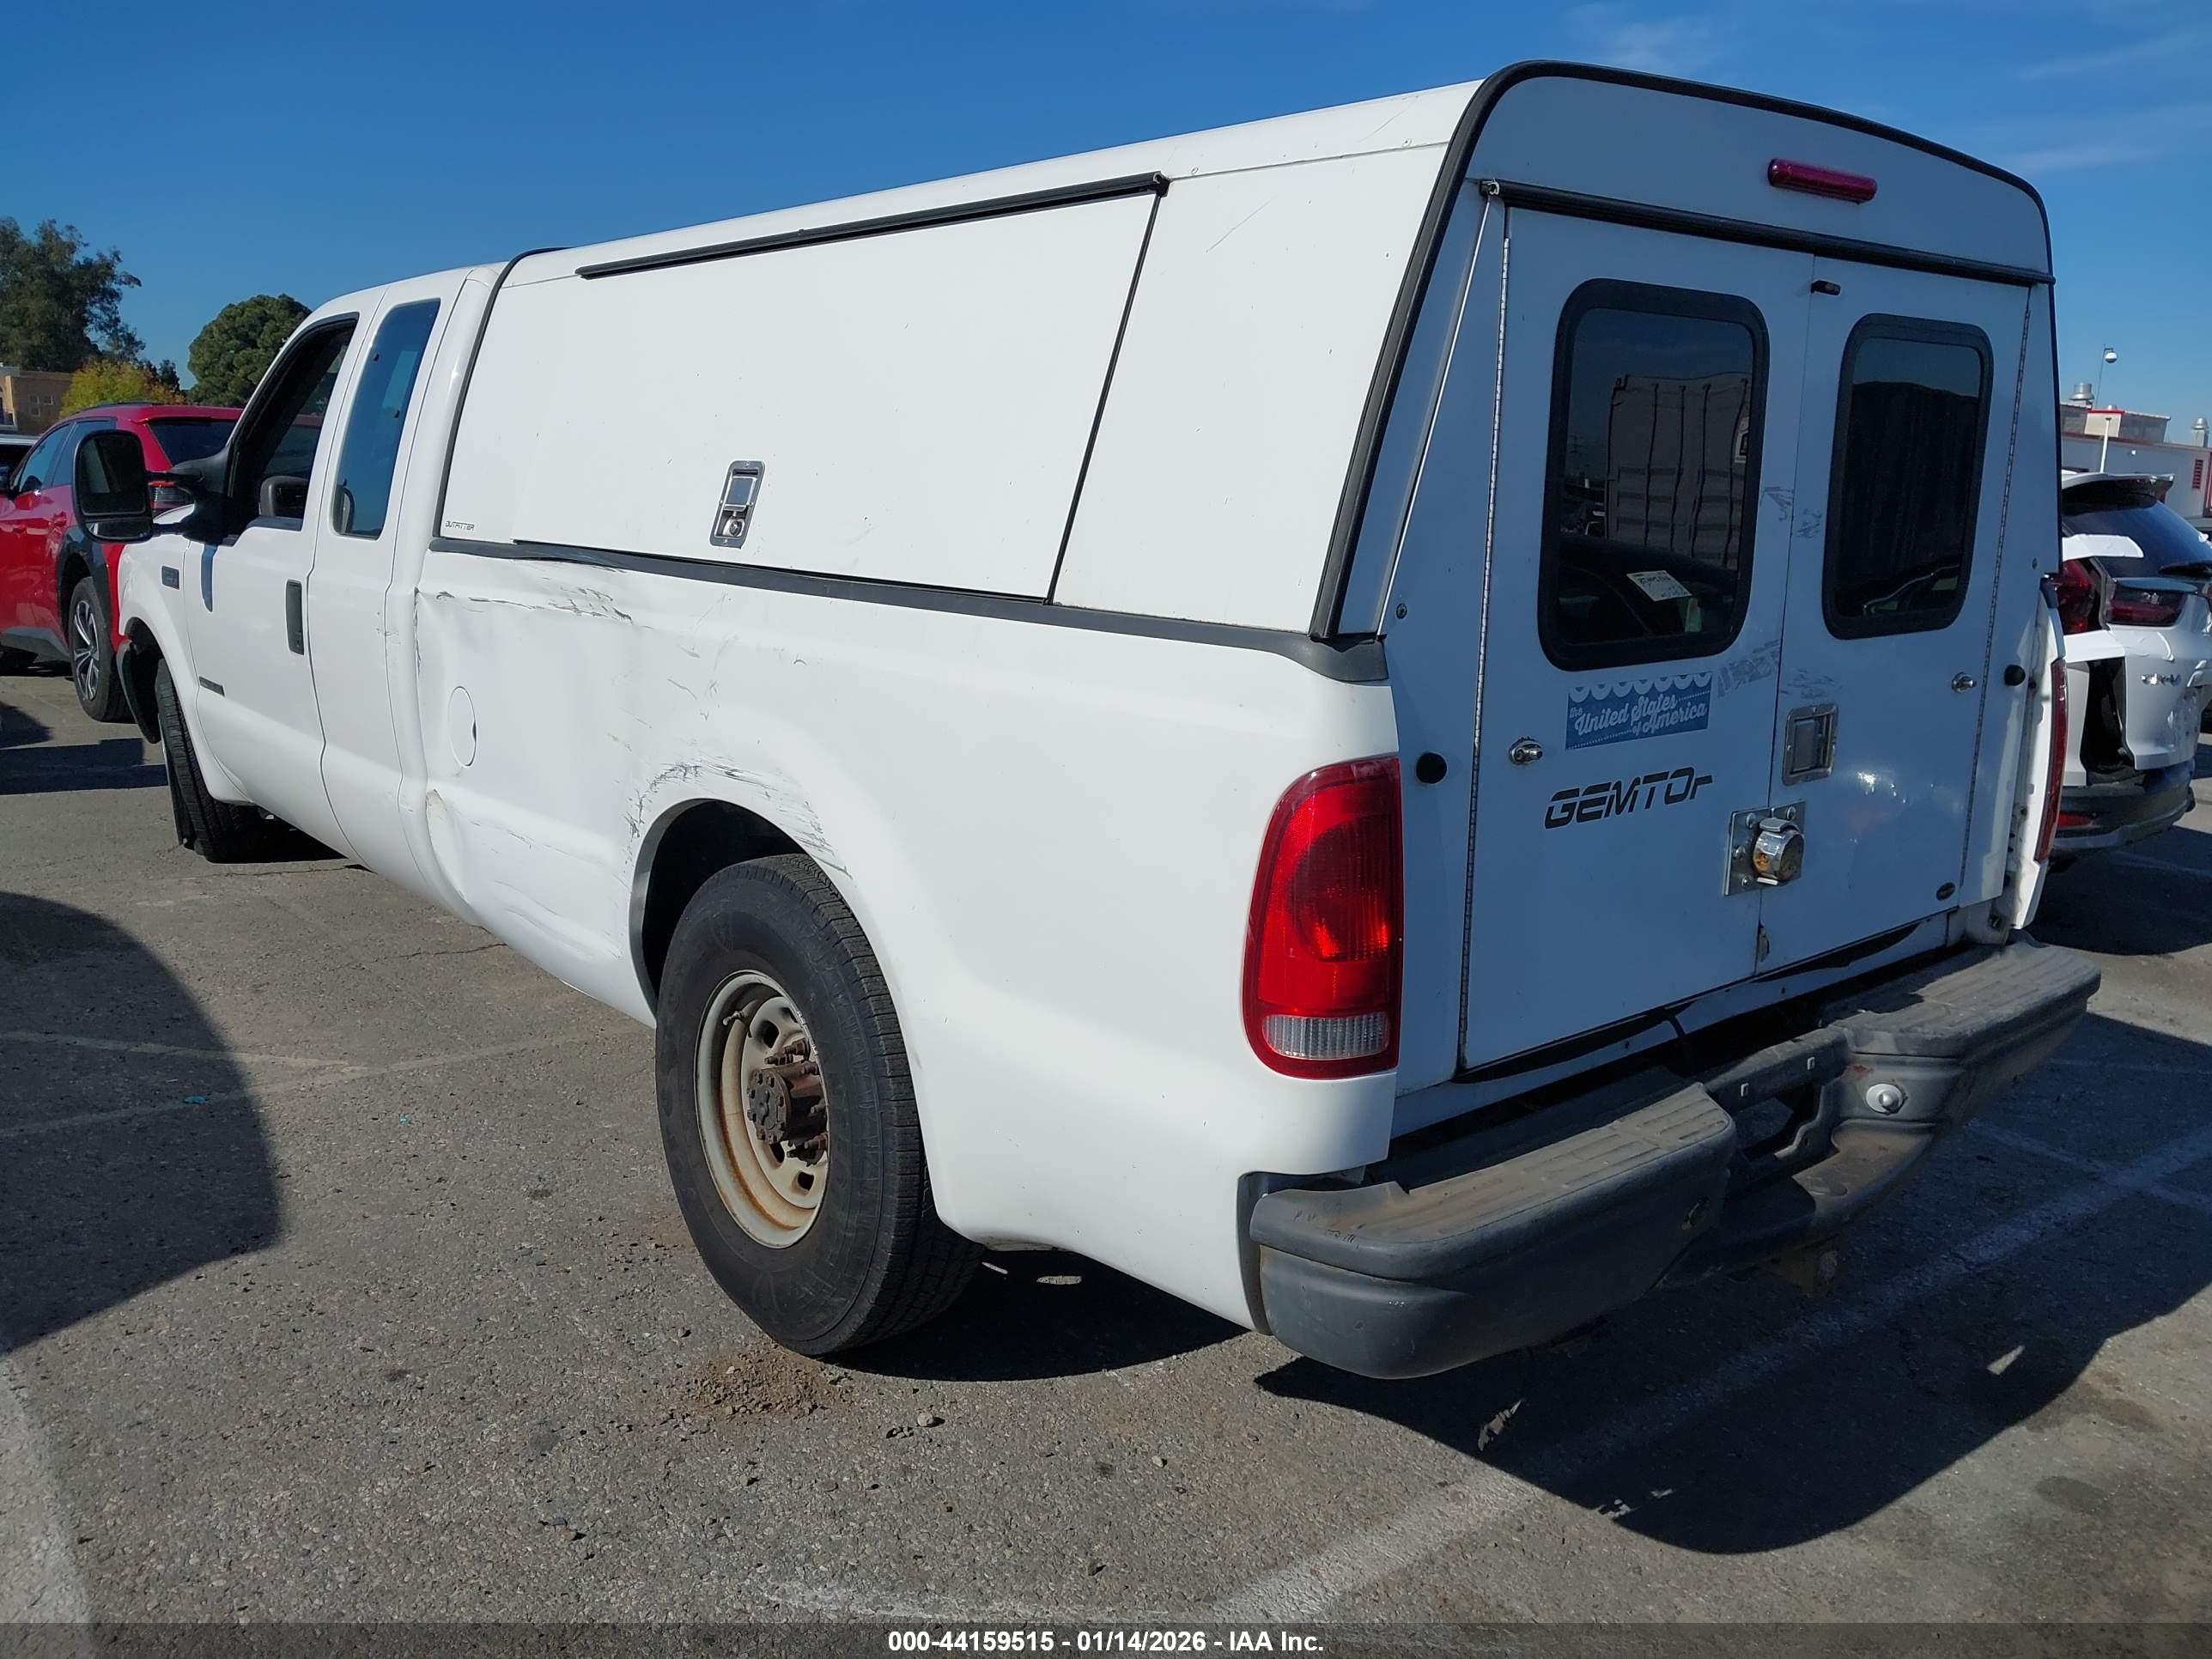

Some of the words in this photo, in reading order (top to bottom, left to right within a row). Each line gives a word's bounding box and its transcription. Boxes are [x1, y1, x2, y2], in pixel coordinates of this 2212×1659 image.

[1569, 707, 1583, 719] the
[1574, 702, 1630, 736] United
[1631, 693, 1677, 726] States
[1642, 702, 1708, 734] America
